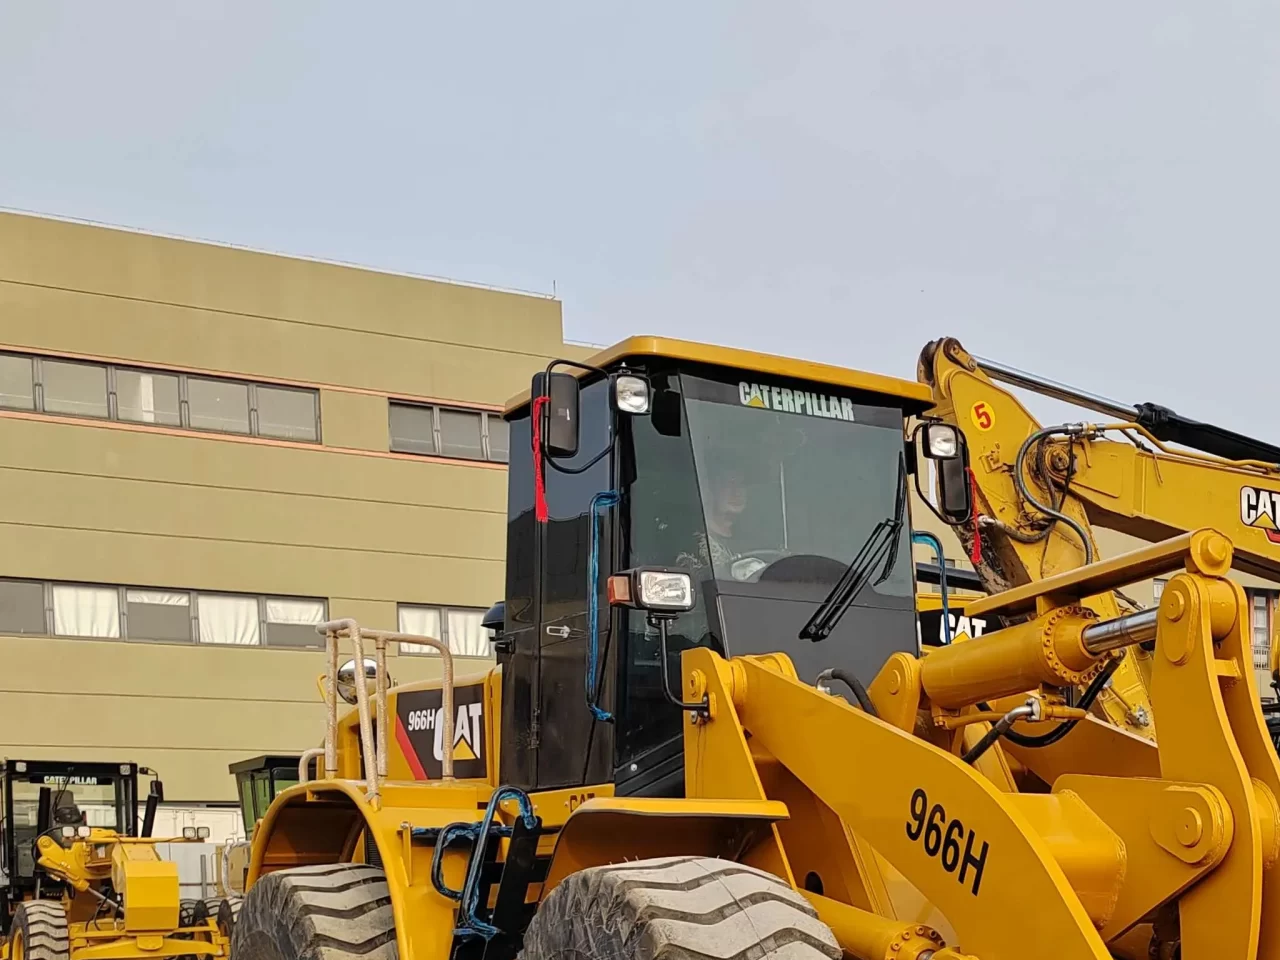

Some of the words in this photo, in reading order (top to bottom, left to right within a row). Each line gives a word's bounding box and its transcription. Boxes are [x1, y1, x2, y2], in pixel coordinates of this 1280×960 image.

[739, 382, 854, 421] CATERPILLAR
[974, 403, 991, 429] 5
[940, 613, 986, 643] CAT
[408, 709, 435, 731] 966H
[906, 788, 989, 897] 966H
